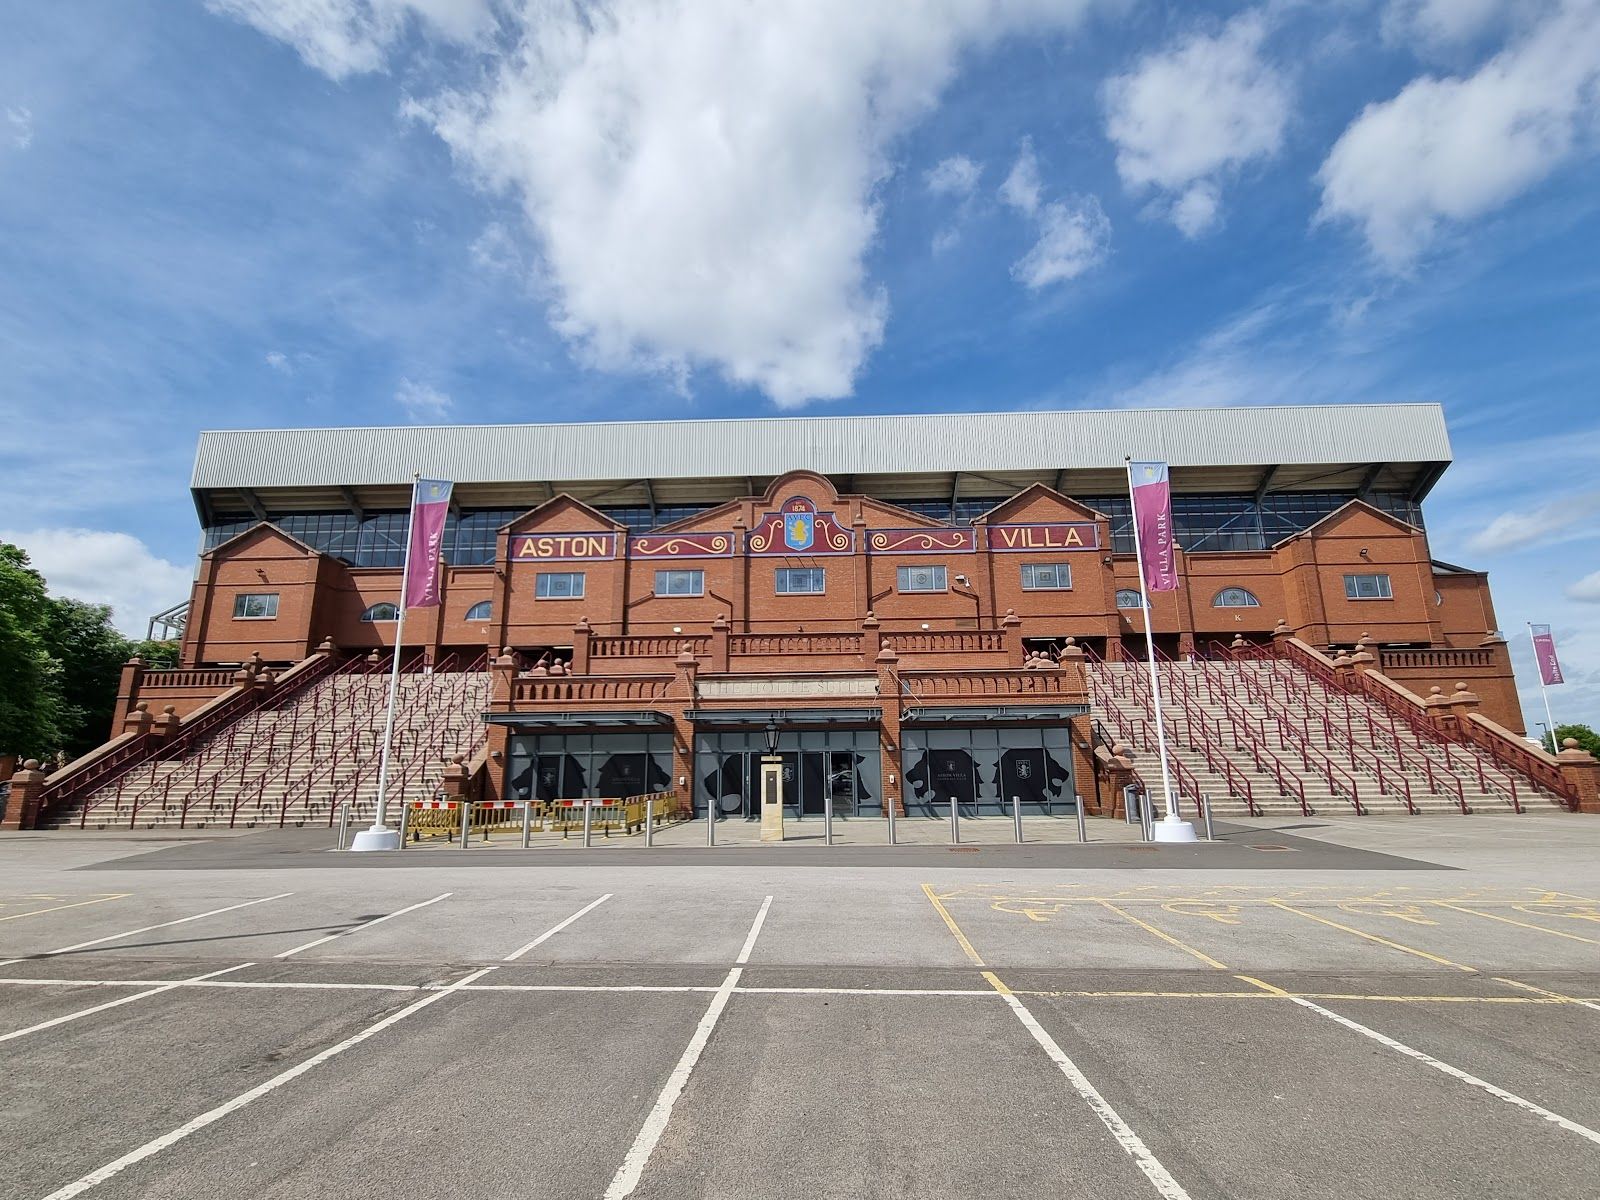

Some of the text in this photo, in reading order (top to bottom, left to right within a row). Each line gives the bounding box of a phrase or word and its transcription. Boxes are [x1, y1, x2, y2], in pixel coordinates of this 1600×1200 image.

[519, 537, 606, 557] ASTON
[1000, 528, 1083, 547] VILLA
[1157, 513, 1170, 585] VILLA PARK
[426, 532, 438, 600] VILLA PARK
[708, 681, 867, 694] THE HOLTE SUITE
